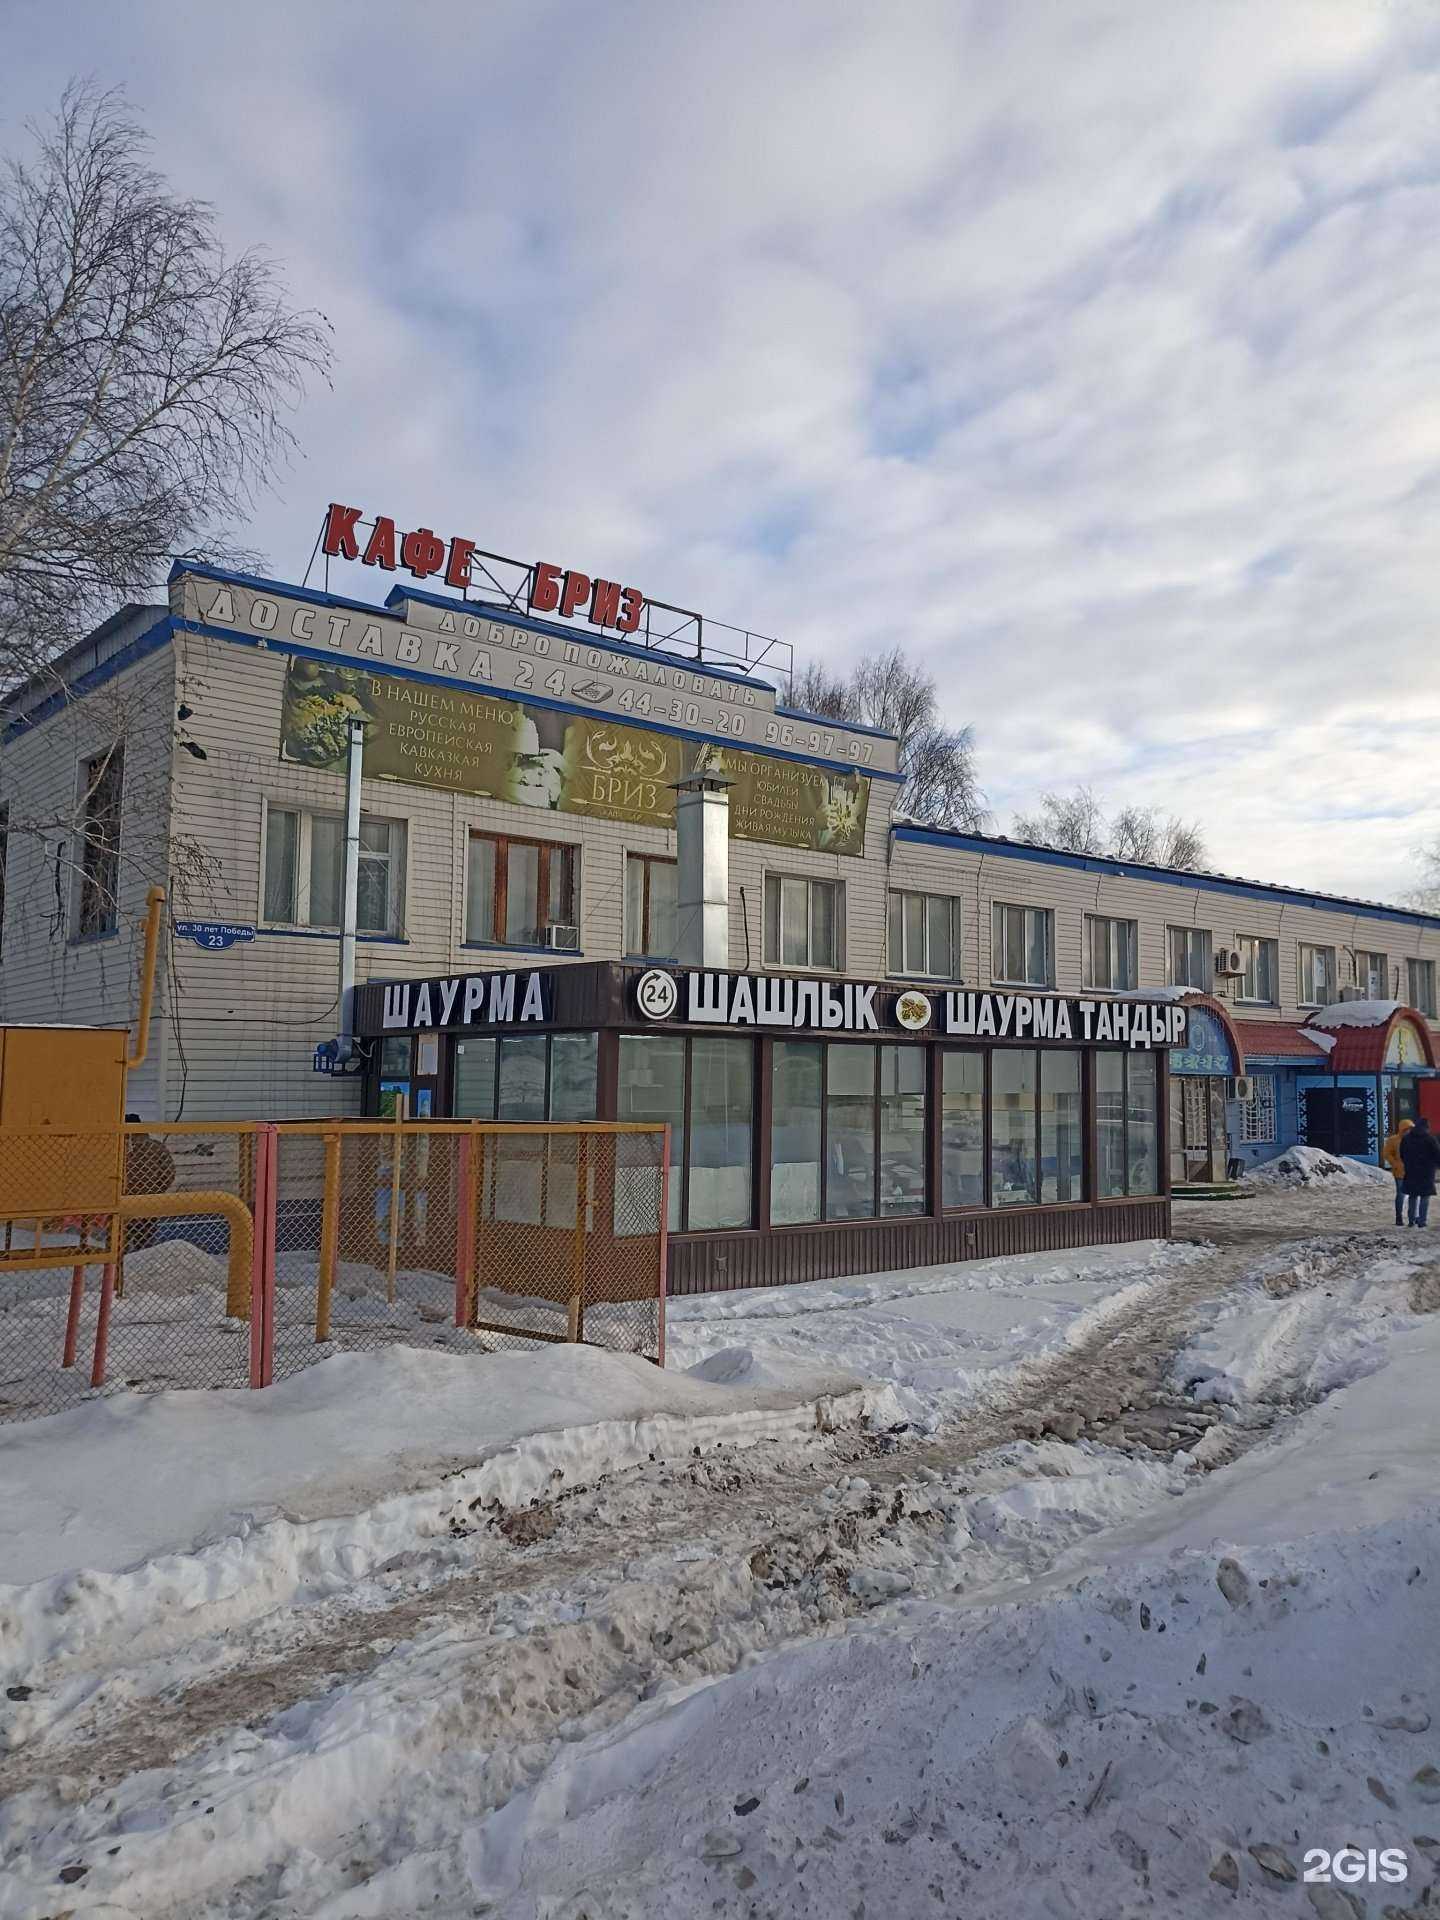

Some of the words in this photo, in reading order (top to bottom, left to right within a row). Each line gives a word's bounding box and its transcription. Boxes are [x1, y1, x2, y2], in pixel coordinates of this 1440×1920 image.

[322, 503, 476, 589] КАФЕ
[529, 561, 644, 633] БРИЗ
[439, 612, 550, 655] ДОБРО
[563, 643, 756, 706] ПОЖАЛОВАТЬ
[206, 589, 493, 680] ДОСТАВКА
[514, 660, 566, 697] 24
[618, 688, 746, 736] 44-30-20
[765, 720, 874, 763] 96-97-97
[371, 679, 382, 696] В
[387, 685, 454, 713] НАШЕМ
[460, 702, 514, 724] МЕНЮ
[410, 710, 477, 734] РУССКАЯ
[414, 762, 463, 781] КУХНЯ
[726, 758, 747, 772] МЫ
[592, 775, 656, 809] БРИЗ
[734, 804, 757, 816] ДНИ
[760, 808, 816, 827] РОЖДЕНИЯ
[735, 819, 771, 832] ЖИВАЯ
[208, 935, 224, 946] 23
[221, 926, 254, 936] Победы
[383, 972, 544, 1029] ШАУРМА
[646, 984, 668, 1003] 24
[688, 972, 879, 1030] ШАШЛЫК
[946, 991, 1072, 1039] ШАУРМА
[1079, 1000, 1186, 1049] ТАНДЫР
